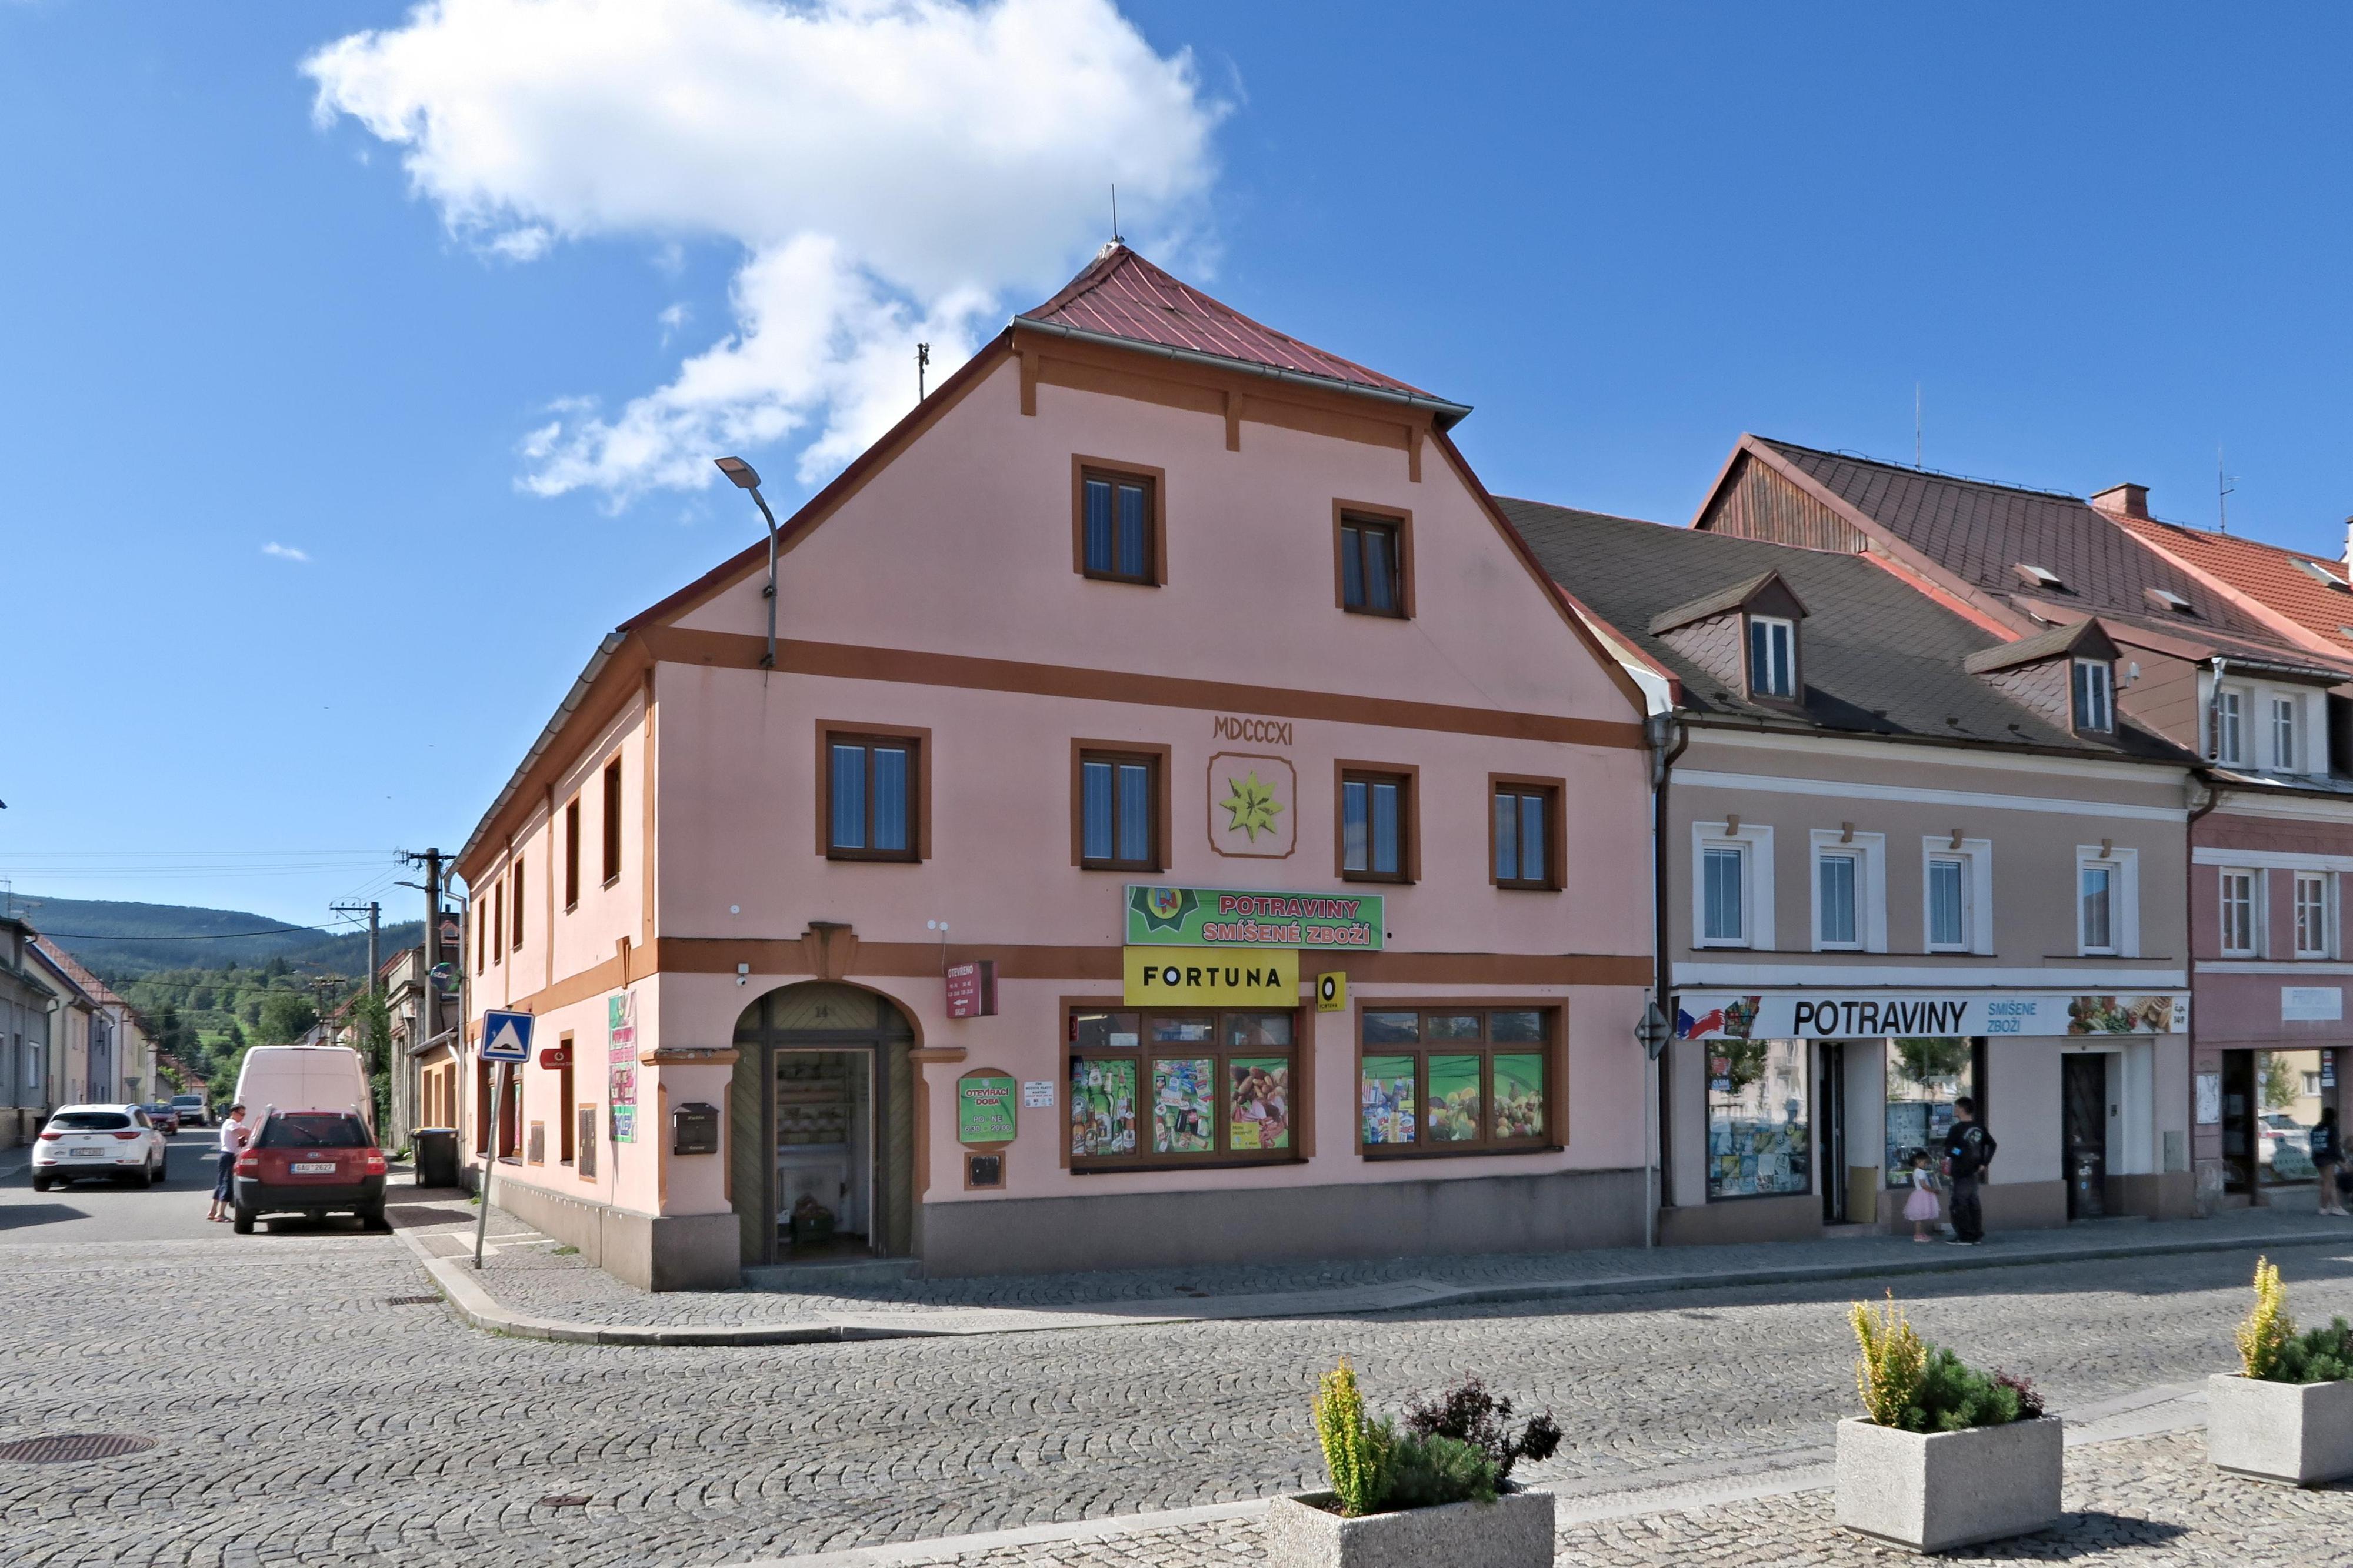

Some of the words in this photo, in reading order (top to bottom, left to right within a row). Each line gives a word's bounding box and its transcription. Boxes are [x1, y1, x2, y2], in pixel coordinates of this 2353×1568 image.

[1213, 716, 1292, 745] MDCCCXI
[1219, 895, 1361, 919] POTRAVINY
[1202, 919, 1301, 943] SMÍŠENÉ
[1306, 923, 1370, 945] ZBOŽÍ
[948, 965, 974, 978] OTEVŘENO
[1144, 966, 1281, 987] FORTUNA
[1794, 1001, 1968, 1035] POTRAVINY
[966, 1087, 1009, 1097] OTEVÍRACÍ
